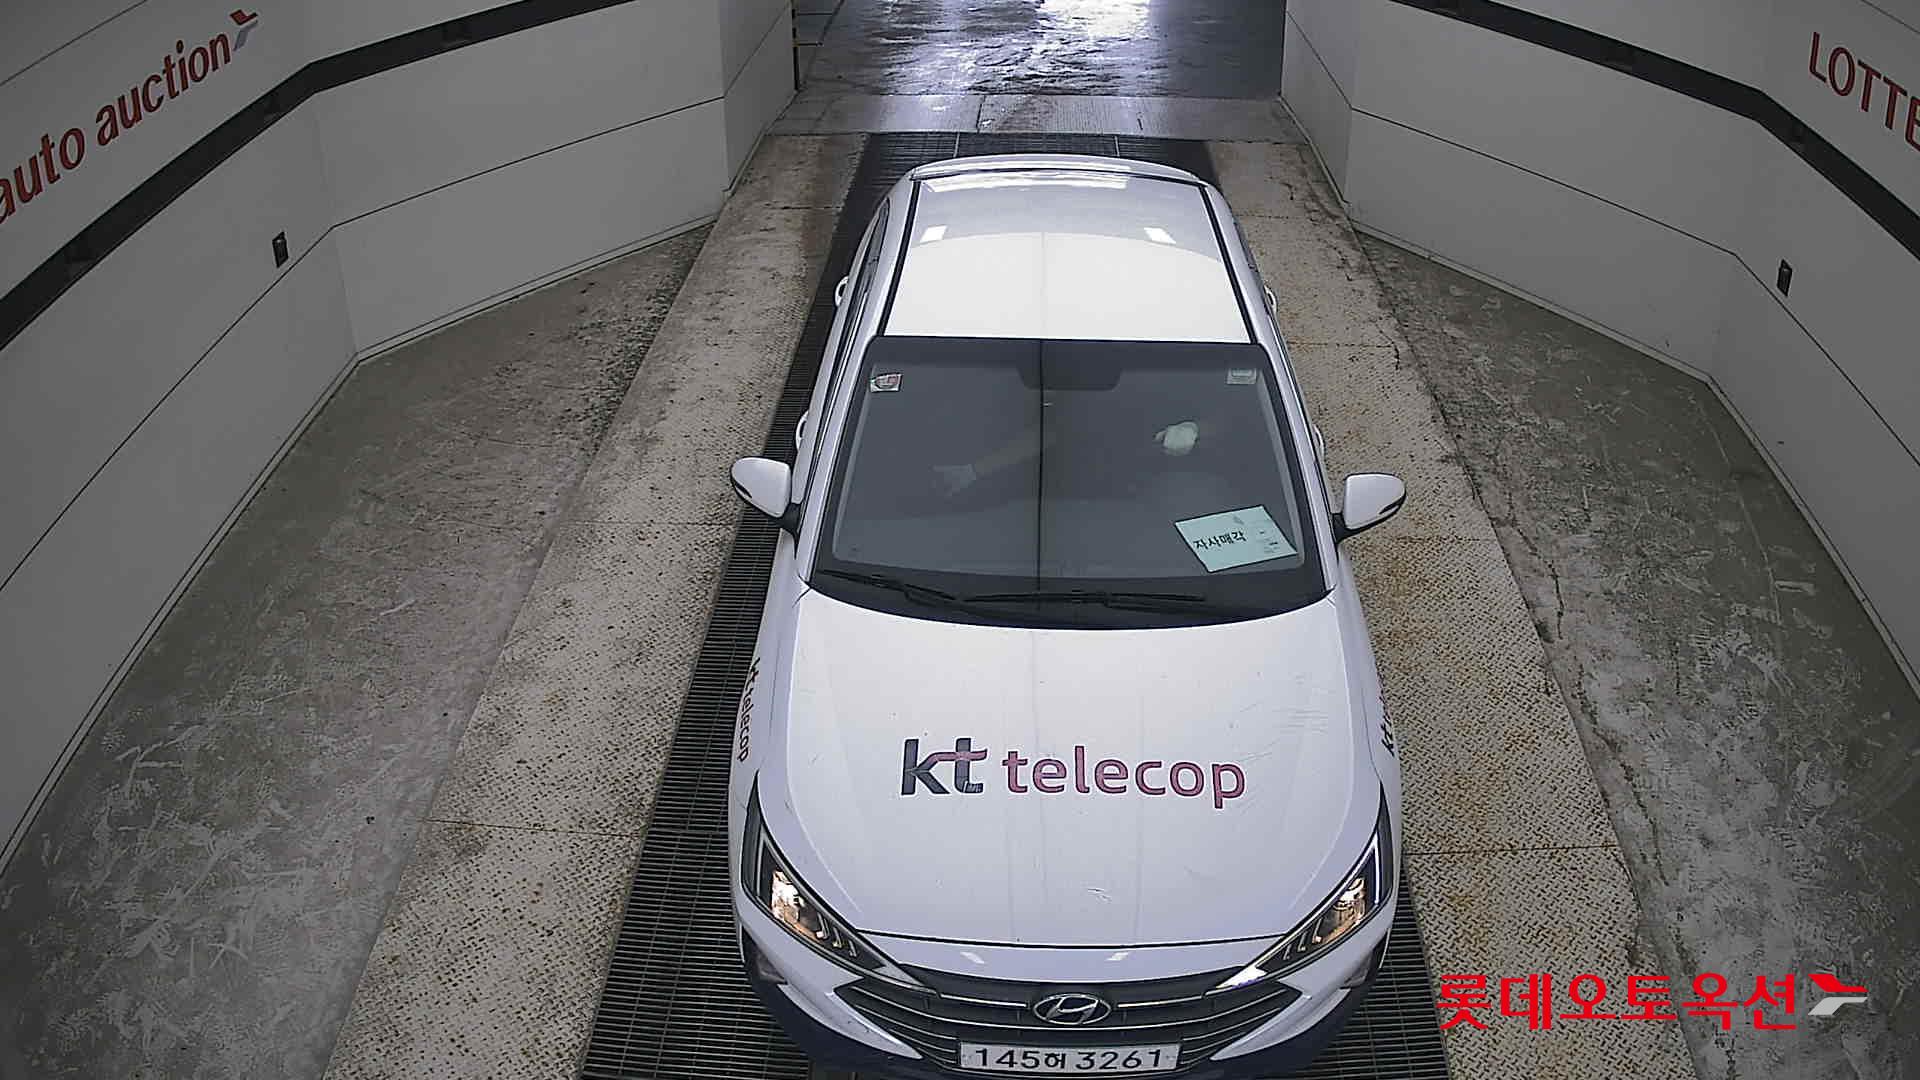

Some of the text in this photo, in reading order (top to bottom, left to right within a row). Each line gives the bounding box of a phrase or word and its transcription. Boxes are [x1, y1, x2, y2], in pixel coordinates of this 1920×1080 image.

[0, 32, 231, 224] auto auction
[1193, 530, 1247, 550] 자사매각
[901, 737, 1246, 809] kt telecop
